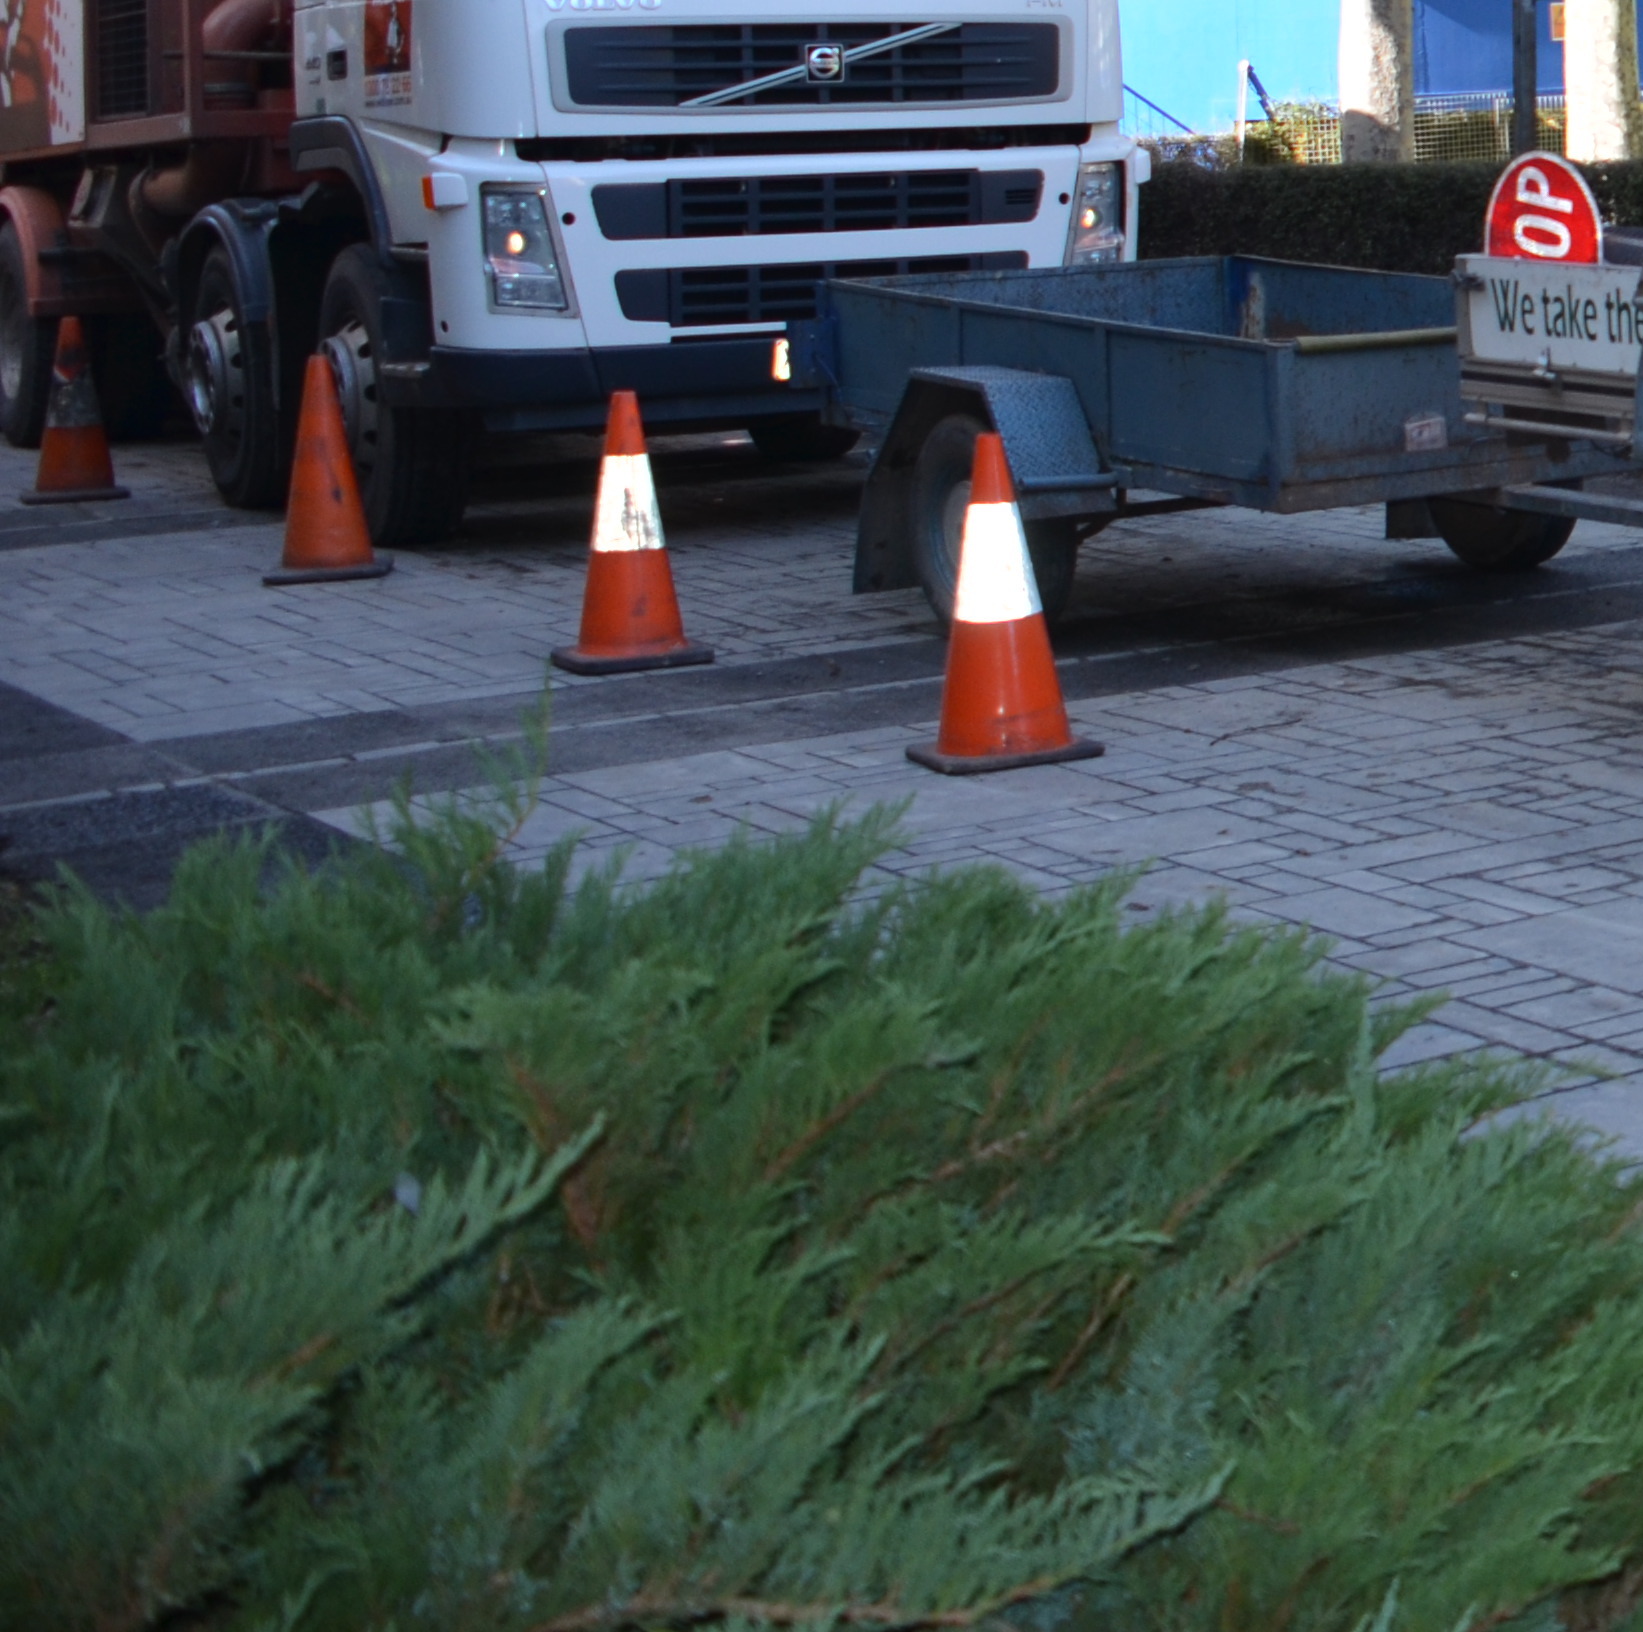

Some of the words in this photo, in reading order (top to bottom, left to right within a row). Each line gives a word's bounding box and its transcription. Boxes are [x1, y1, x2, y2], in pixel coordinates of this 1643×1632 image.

[1514, 166, 1573, 258] OP
[1491, 278, 1535, 335] We
[1542, 284, 1597, 341] take
